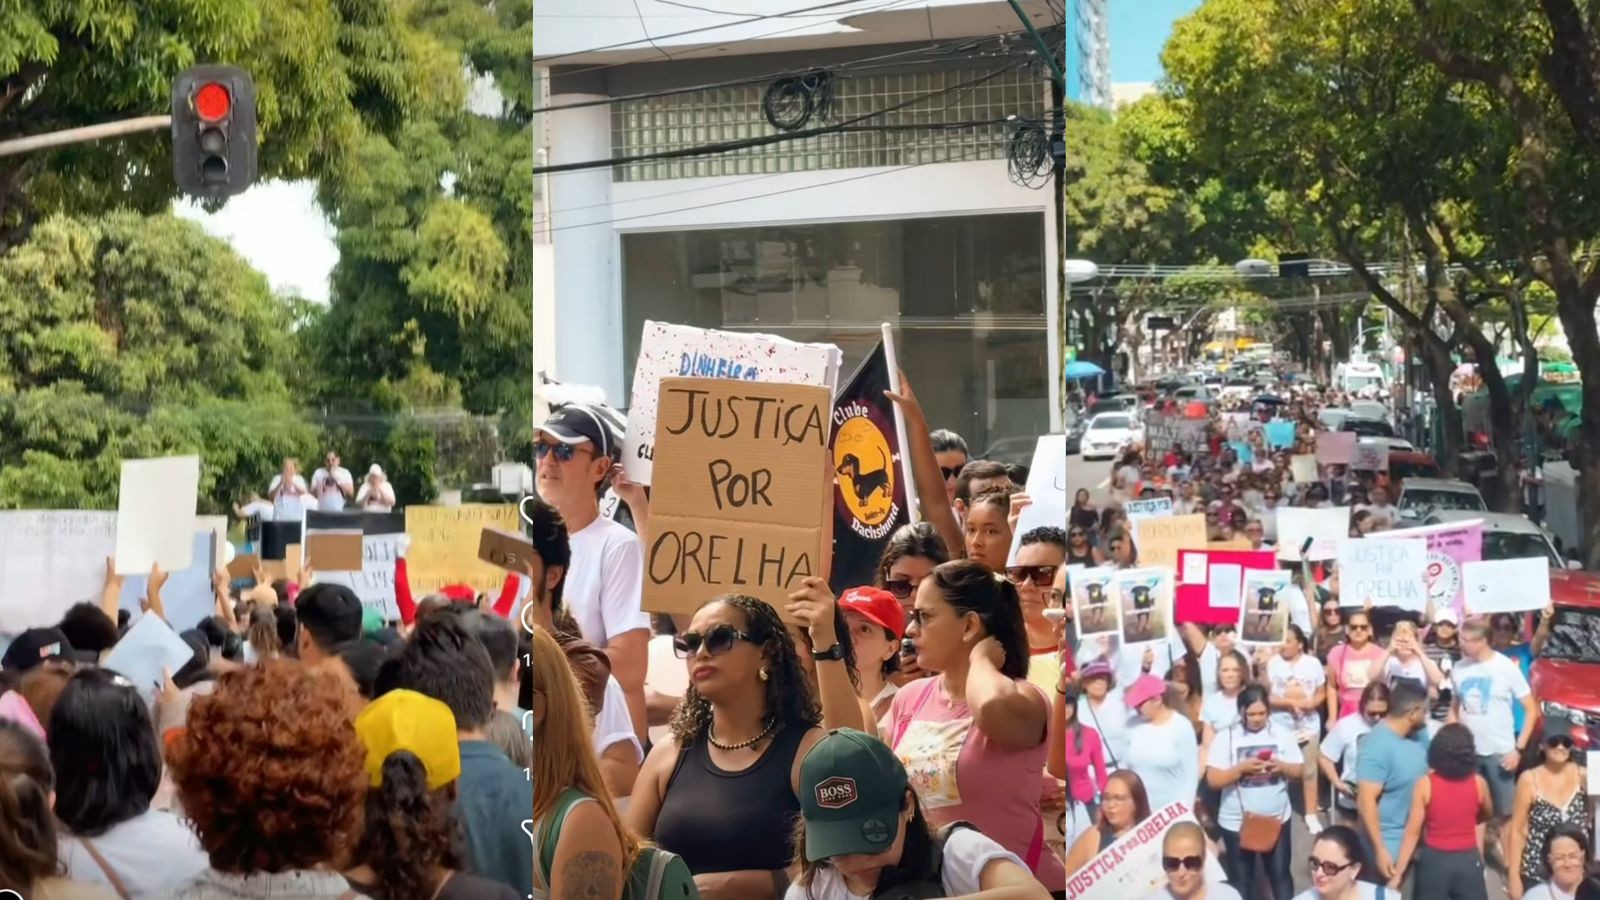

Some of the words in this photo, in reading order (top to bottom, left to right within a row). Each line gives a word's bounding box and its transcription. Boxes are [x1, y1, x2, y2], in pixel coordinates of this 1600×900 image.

[833, 401, 869, 426] Clube
[708, 458, 773, 511] POR
[649, 531, 812, 590] ORELHA
[820, 784, 852, 799] BOSS
[1136, 801, 1189, 845] ORELHA
